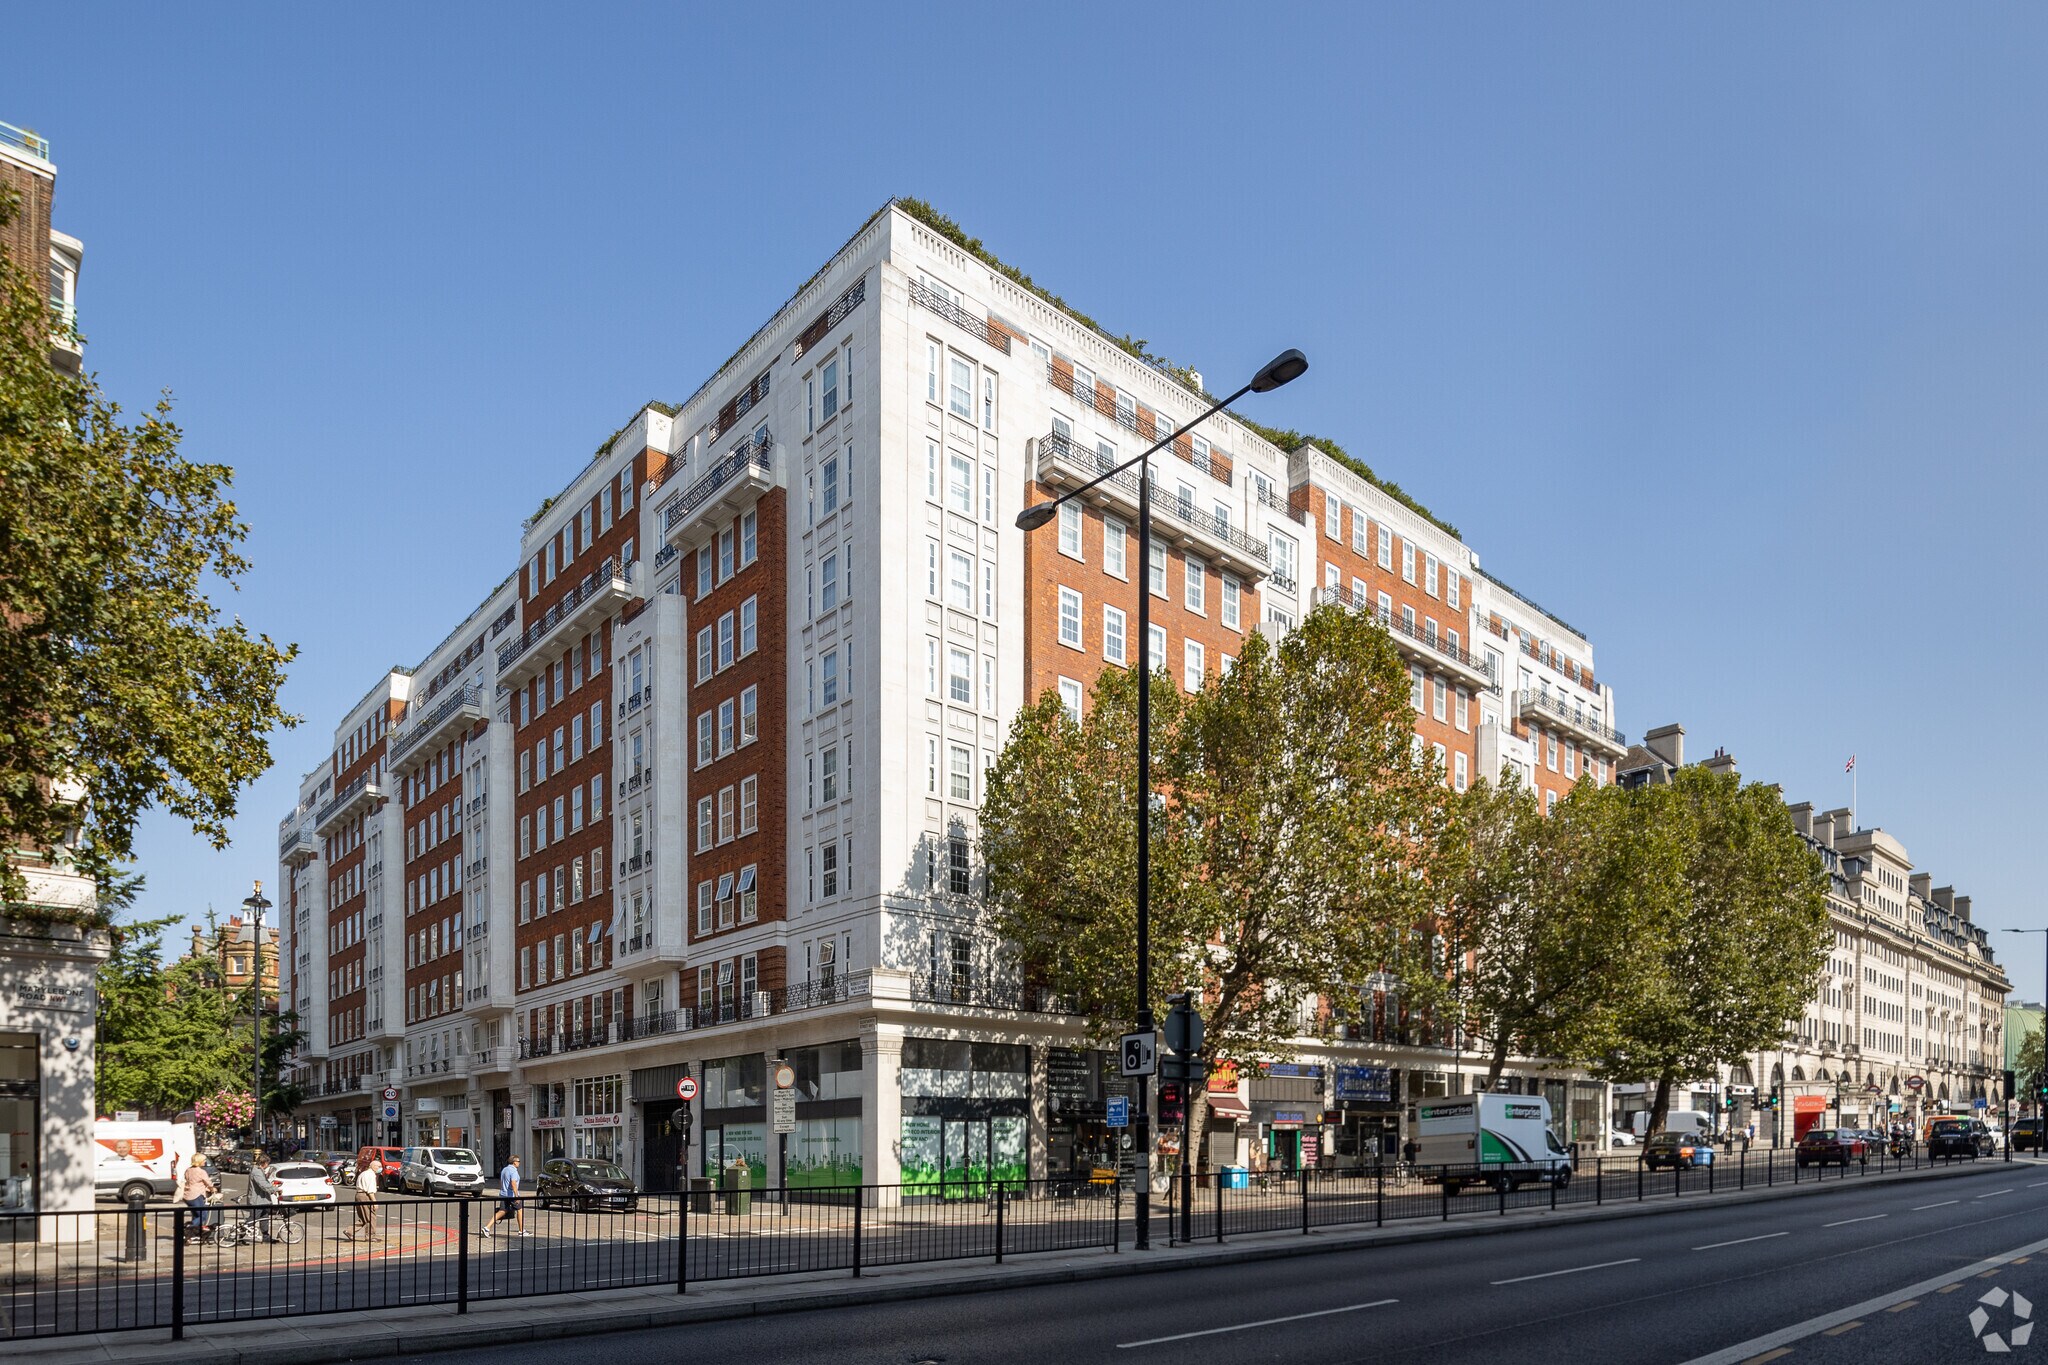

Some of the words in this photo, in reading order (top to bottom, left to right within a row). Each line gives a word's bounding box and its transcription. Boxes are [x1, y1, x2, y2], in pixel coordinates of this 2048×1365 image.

[19, 985, 85, 997] MARYLEBONE
[19, 993, 46, 1001] ROAD
[1422, 1105, 1472, 1117] enterprise
[1506, 1107, 1541, 1118] enterprise
[595, 1116, 611, 1124] Holidays
